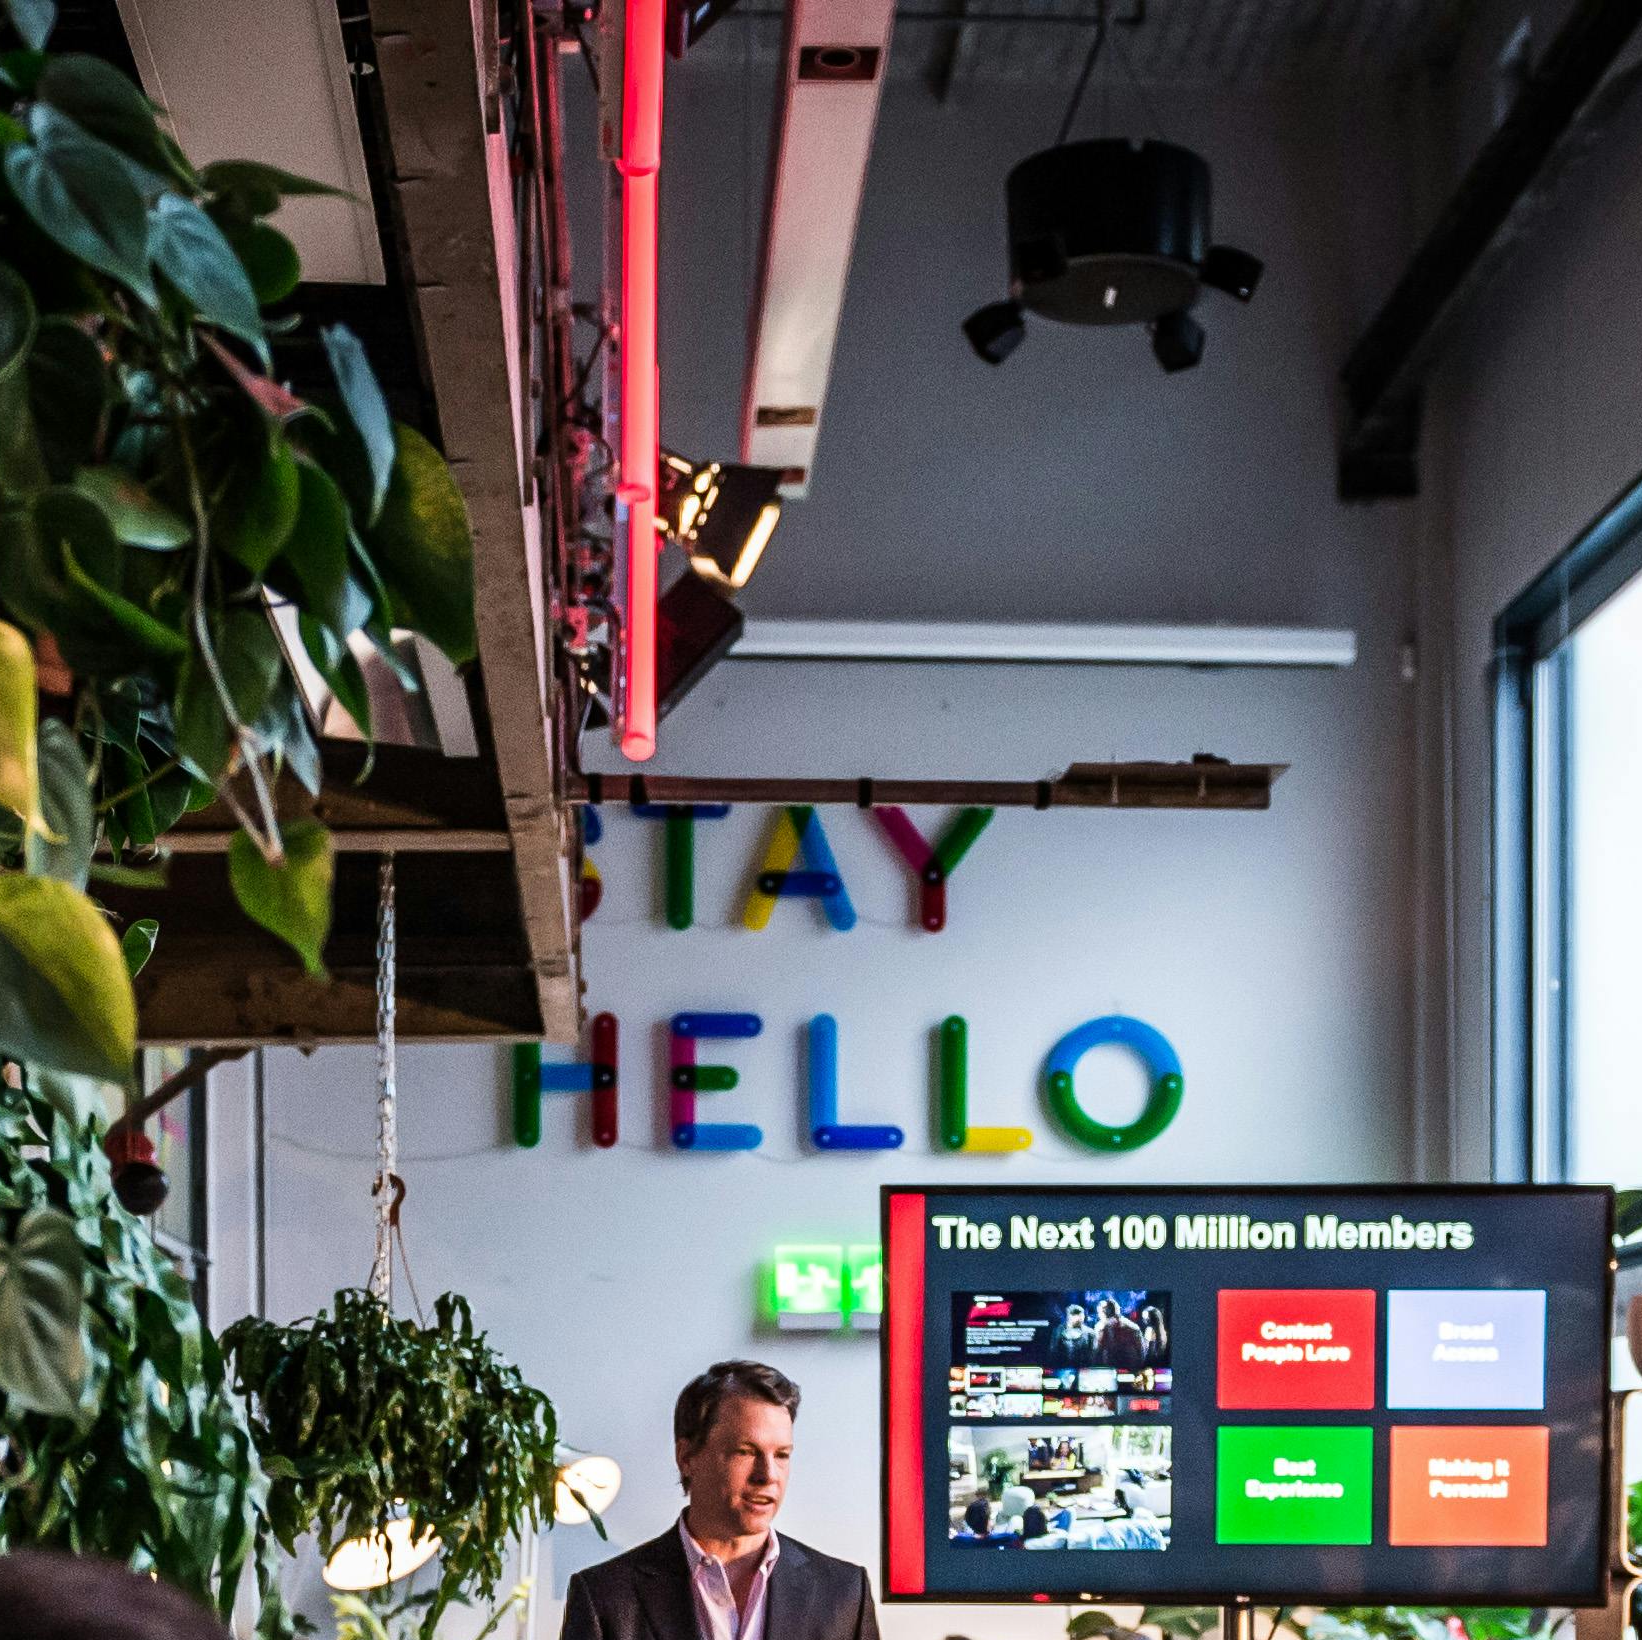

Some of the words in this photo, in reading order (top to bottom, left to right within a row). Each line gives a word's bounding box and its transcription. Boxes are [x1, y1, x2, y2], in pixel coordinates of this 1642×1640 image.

[581, 804, 996, 932] TAY
[513, 1012, 1184, 1152] HELLO
[931, 1214, 1003, 1250] The
[1009, 1214, 1095, 1250] Next
[1102, 1214, 1167, 1250] 100
[1174, 1214, 1296, 1250] Million
[1303, 1213, 1474, 1250] Members
[1260, 1321, 1333, 1341] Content
[1241, 1343, 1304, 1365] People
[1305, 1343, 1351, 1362] Love
[1273, 1457, 1317, 1477] Best
[1429, 1458, 1493, 1480] Making
[1245, 1479, 1344, 1501] Experience
[1429, 1479, 1509, 1498] Personal
